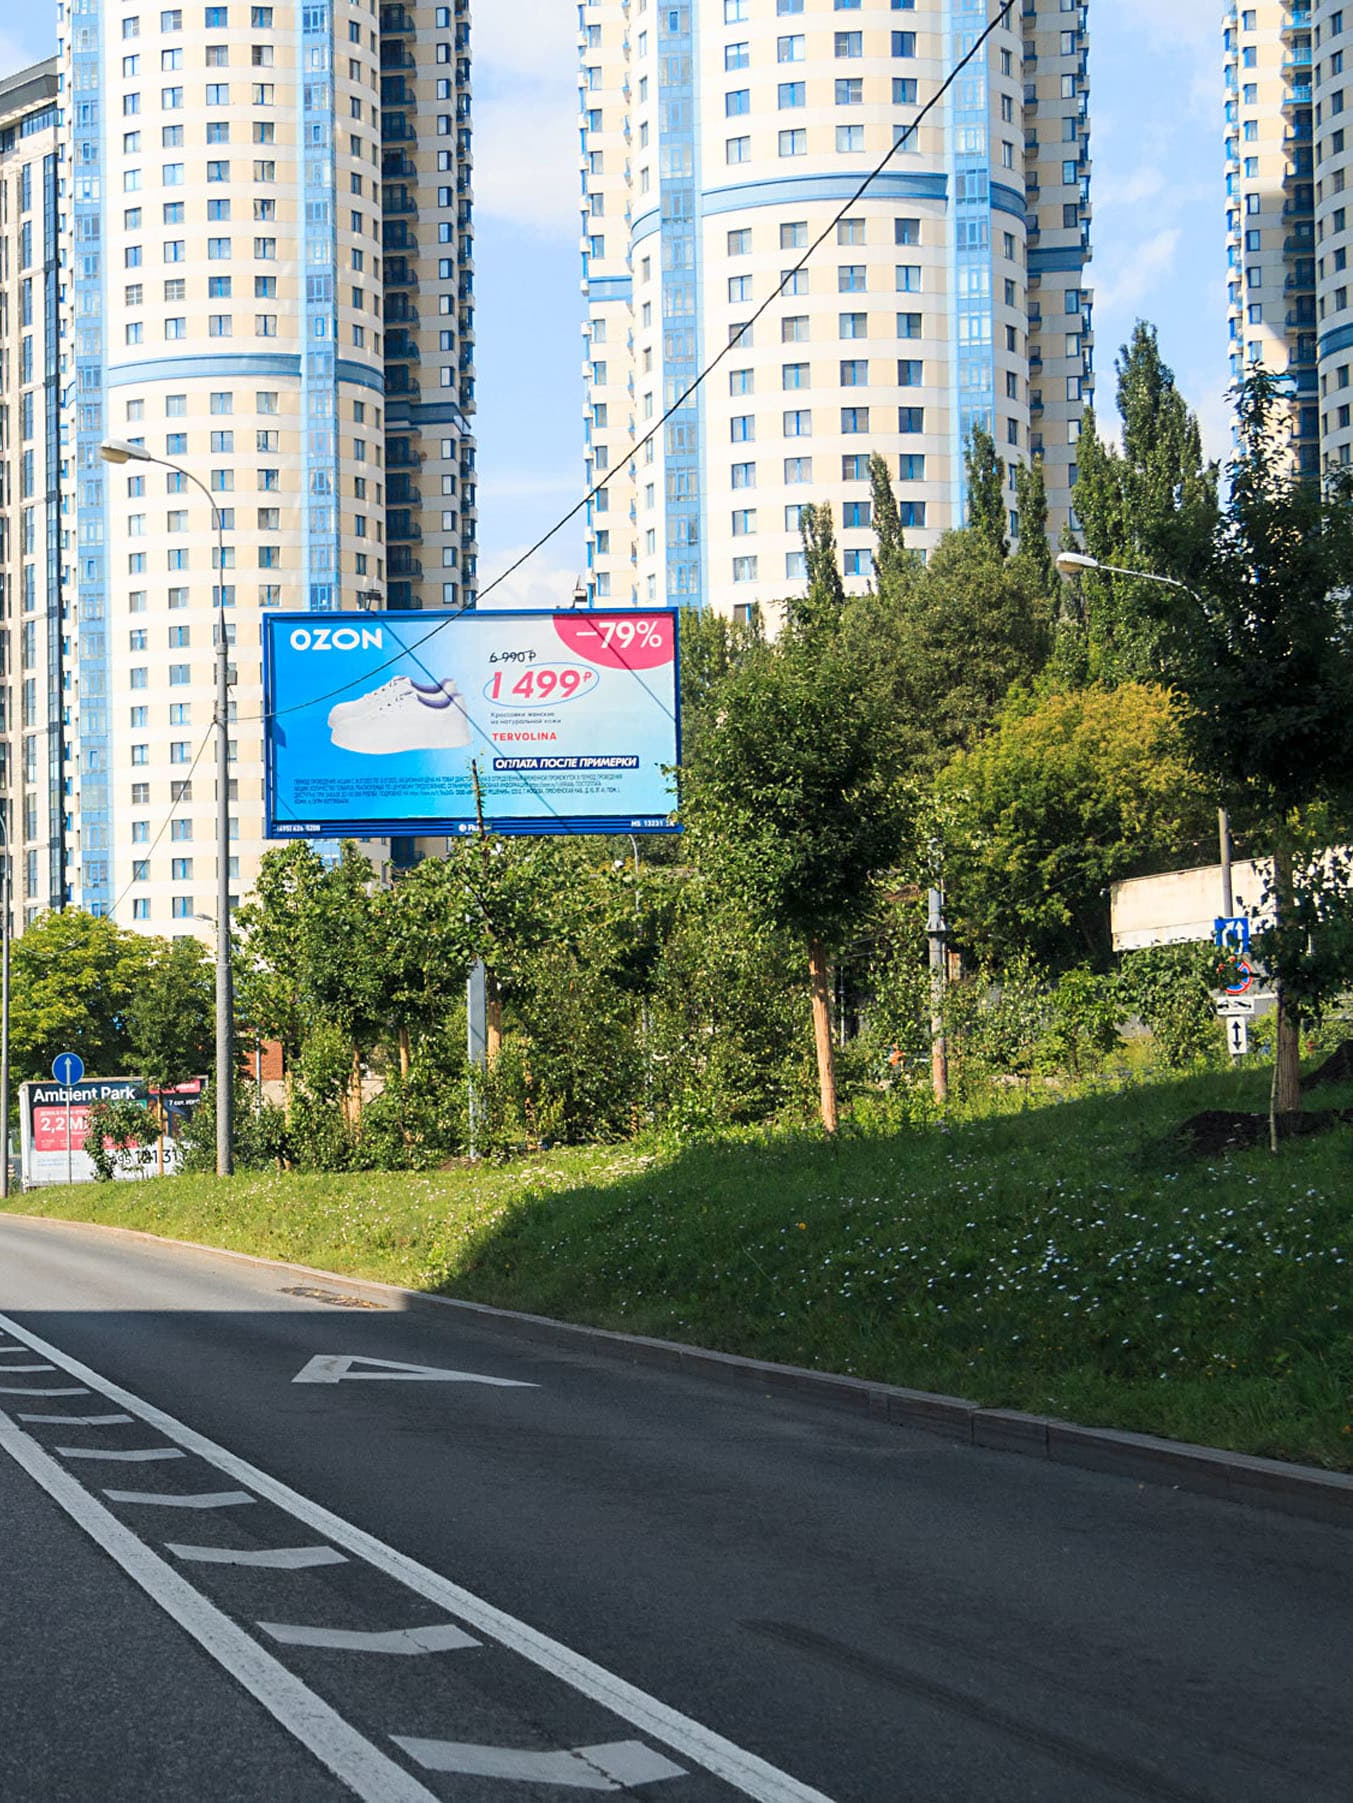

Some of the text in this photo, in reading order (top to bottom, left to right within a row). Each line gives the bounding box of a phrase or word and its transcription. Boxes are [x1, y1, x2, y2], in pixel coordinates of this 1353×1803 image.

[290, 628, 383, 651] OZON
[576, 621, 662, 648] -79%
[492, 731, 558, 742] TERVOLINA
[495, 757, 637, 769] ОПЛАТА ПОСЛЕ ПРИМЕРКИ
[33, 1086, 136, 1103] Ambient Park
[41, 1117, 65, 1133] 2,2
